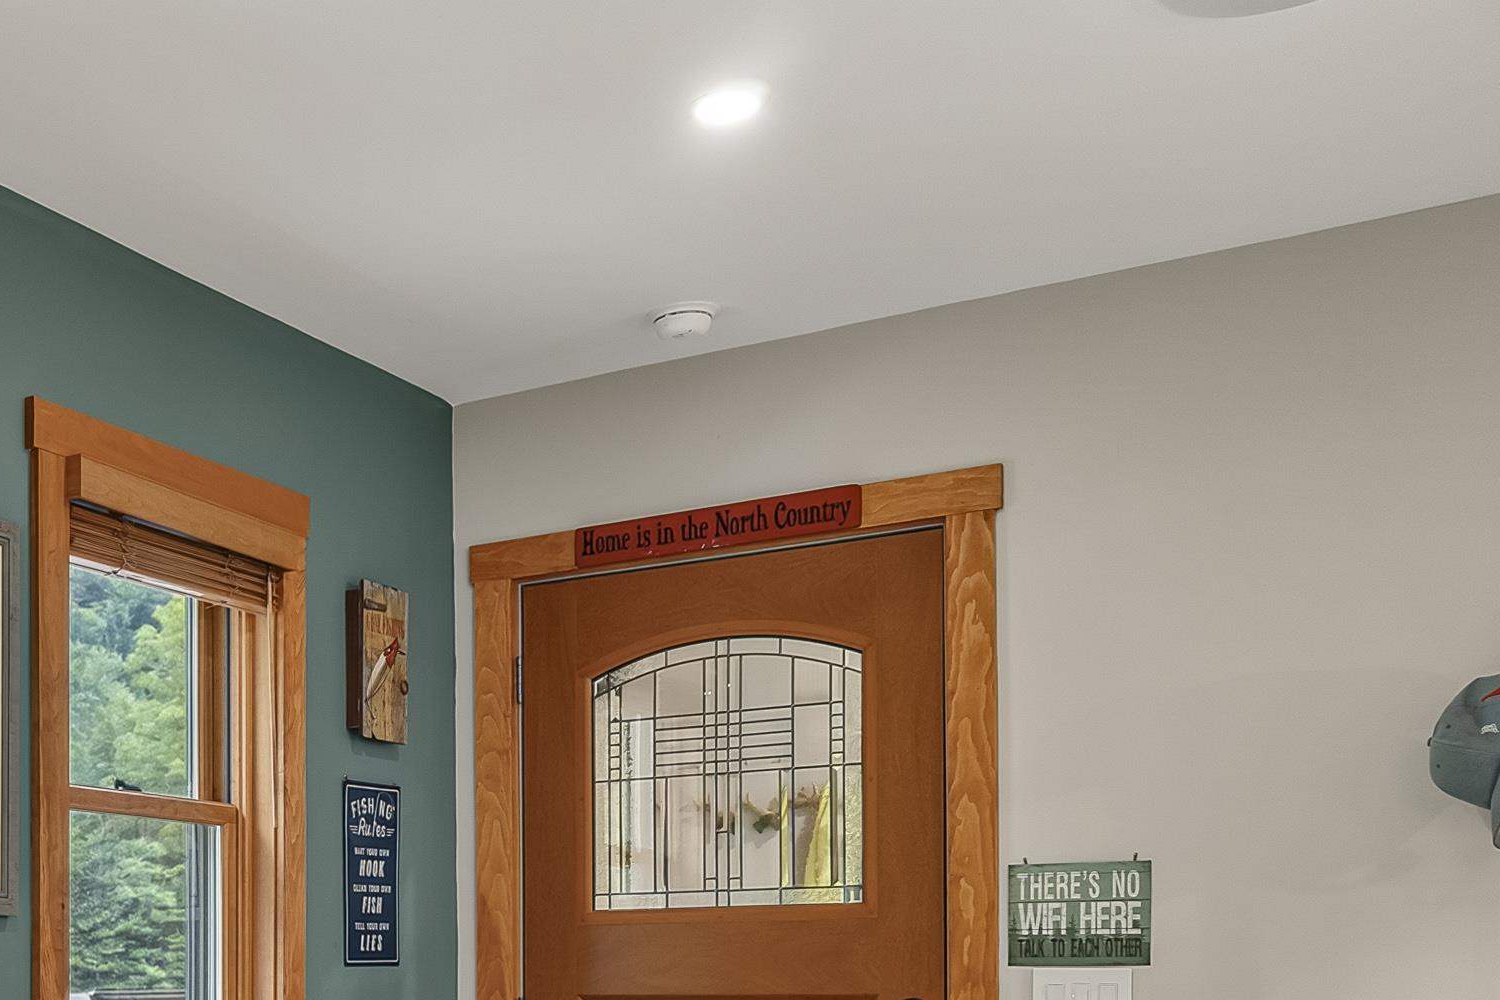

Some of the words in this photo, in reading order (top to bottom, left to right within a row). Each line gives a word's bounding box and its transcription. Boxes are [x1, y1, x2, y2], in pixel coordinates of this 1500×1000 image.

[581, 528, 630, 557] Home
[635, 524, 651, 549] is
[656, 521, 675, 546] in
[681, 515, 708, 541] the
[714, 505, 769, 538] North
[773, 499, 853, 530] Country
[358, 817, 386, 838] Rules
[359, 859, 385, 878] HOOK
[1017, 870, 1101, 900] THERE'S
[1112, 869, 1141, 899] NO
[361, 896, 383, 914] FISH
[1017, 902, 1067, 936] WIFI
[1079, 901, 1142, 935] HERE
[360, 934, 383, 952] LIES
[1017, 938, 1045, 958] TALK
[1051, 937, 1066, 958] TO
[1070, 937, 1100, 958] EACH
[1105, 937, 1143, 958] OTHER
